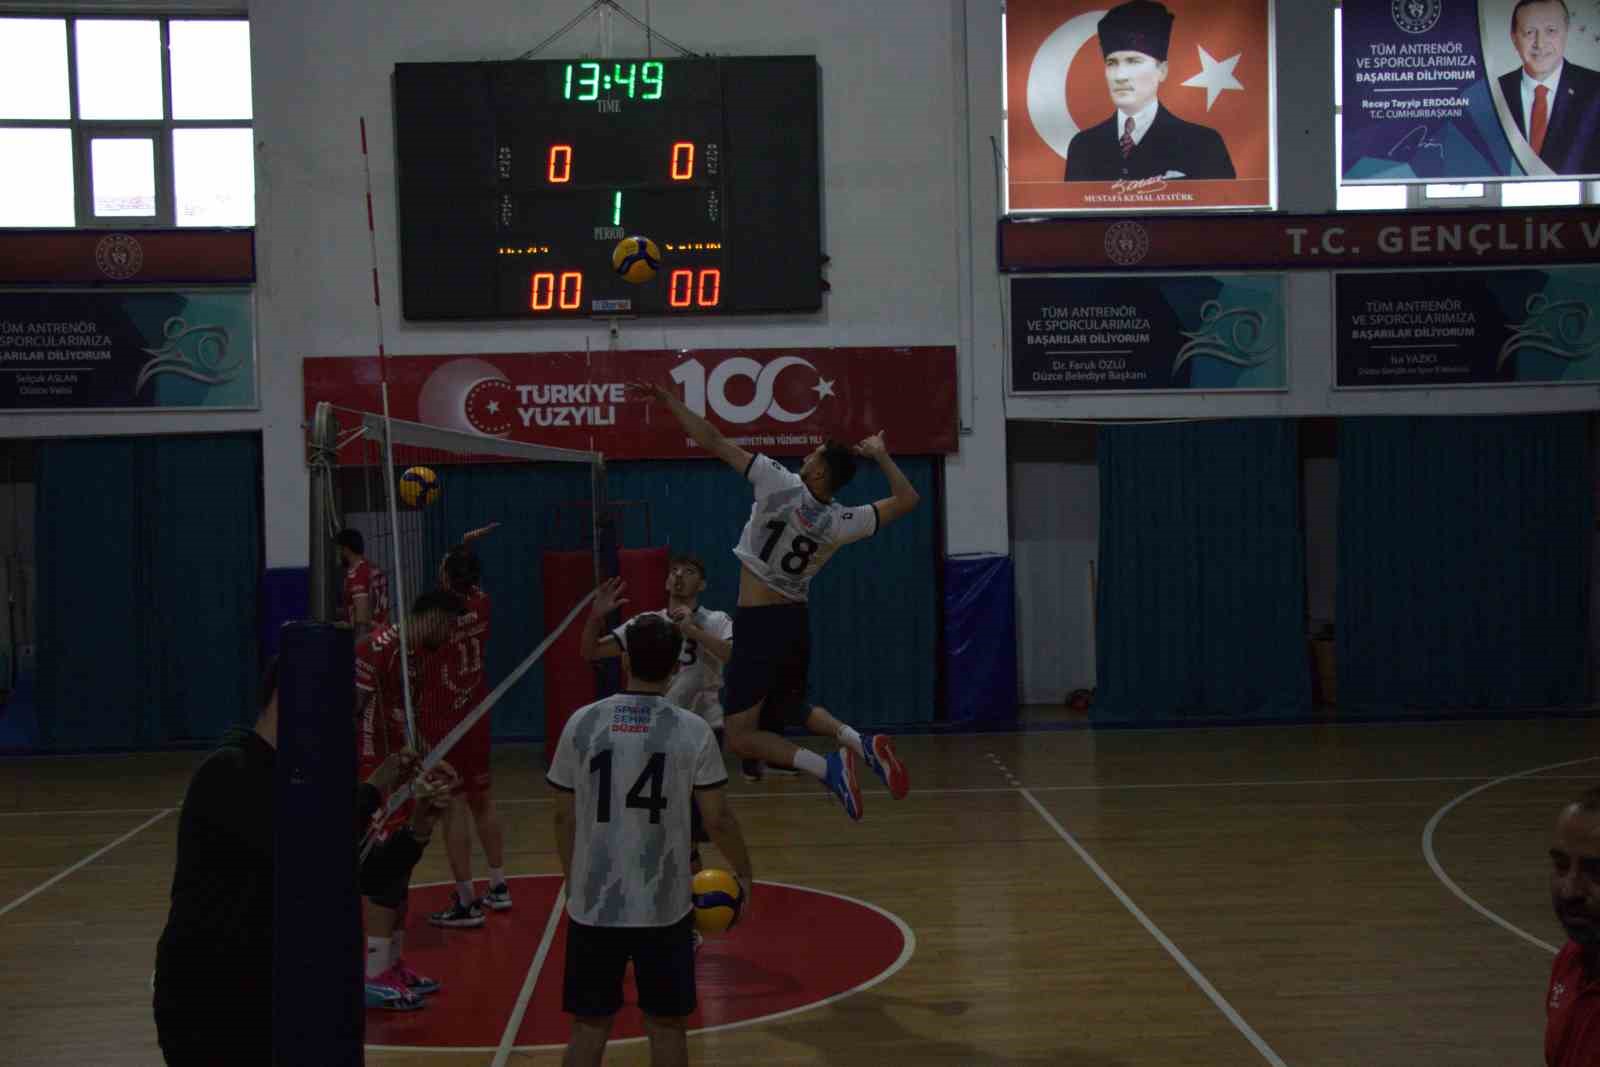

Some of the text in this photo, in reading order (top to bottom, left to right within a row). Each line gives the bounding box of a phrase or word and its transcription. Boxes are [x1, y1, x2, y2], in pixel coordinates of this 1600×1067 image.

[1369, 41, 1463, 55] TÜM ANTRENÖR
[1355, 55, 1477, 69] VE SPORCULARIMIZA
[562, 61, 665, 101] 13:49
[1355, 69, 1475, 83] BAŞARILAR DİLİYORUM
[1361, 96, 1469, 110] Recep Tayyip ERDOĞAN
[548, 145, 573, 183] 0
[671, 142, 695, 180] 0
[612, 191, 622, 225] 1
[1285, 227, 1360, 255] T.C.
[1377, 217, 1564, 255] GENÇLİK
[1041, 304, 1136, 318] TÜM ANTRENÖR
[1366, 298, 1462, 313] TÜM ANTRENÖR
[1027, 319, 1151, 331] VE SPORCULARIMIZA
[1352, 312, 1476, 326] VE SPORCULARIMIZA
[26, 320, 96, 334] ANTRENÖR
[1352, 328, 1411, 341] BAŞARILAR
[1027, 332, 1151, 348] BAŞARILAR DİLİYORUM
[47, 350, 112, 361] DİLİYORUM
[515, 379, 624, 404] TÜRKİYE
[517, 404, 615, 428] YÜZYILI
[759, 520, 818, 574] 18
[589, 750, 667, 825] 14
